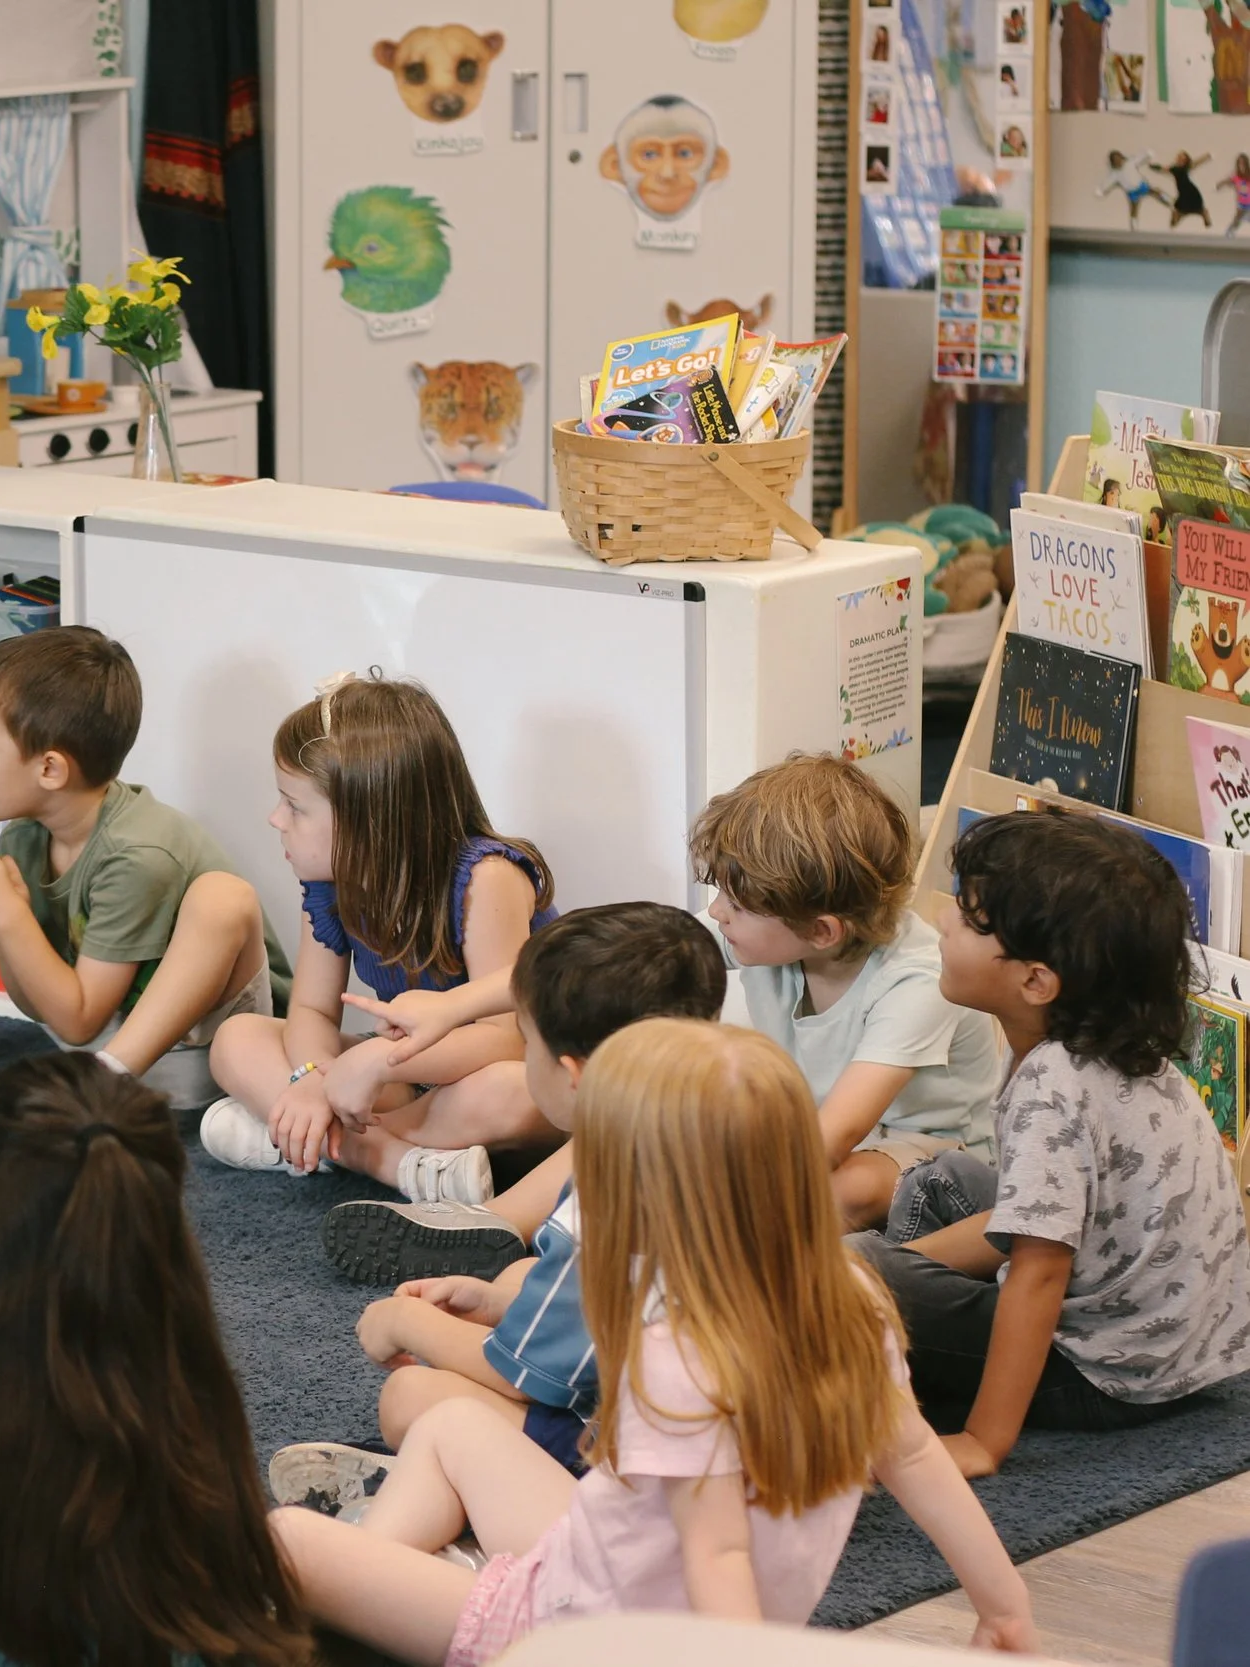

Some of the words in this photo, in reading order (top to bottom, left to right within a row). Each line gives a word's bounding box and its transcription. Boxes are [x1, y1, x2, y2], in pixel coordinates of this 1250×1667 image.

[616, 360, 672, 385] Let's
[677, 350, 716, 373] Go!
[1146, 416, 1159, 434] The
[1126, 459, 1156, 491] Jesu
[1030, 531, 1116, 579] DRAGONS
[1050, 569, 1100, 607] LOVE
[1212, 561, 1250, 592] FRIEN
[850, 631, 886, 648] DRAMATIC
[887, 626, 905, 637] PLAY
[1043, 600, 1112, 646] TACOS
[1016, 687, 1043, 730] This
[1045, 695, 1060, 739] I
[1061, 704, 1102, 749] Know
[1210, 767, 1250, 807] That'
